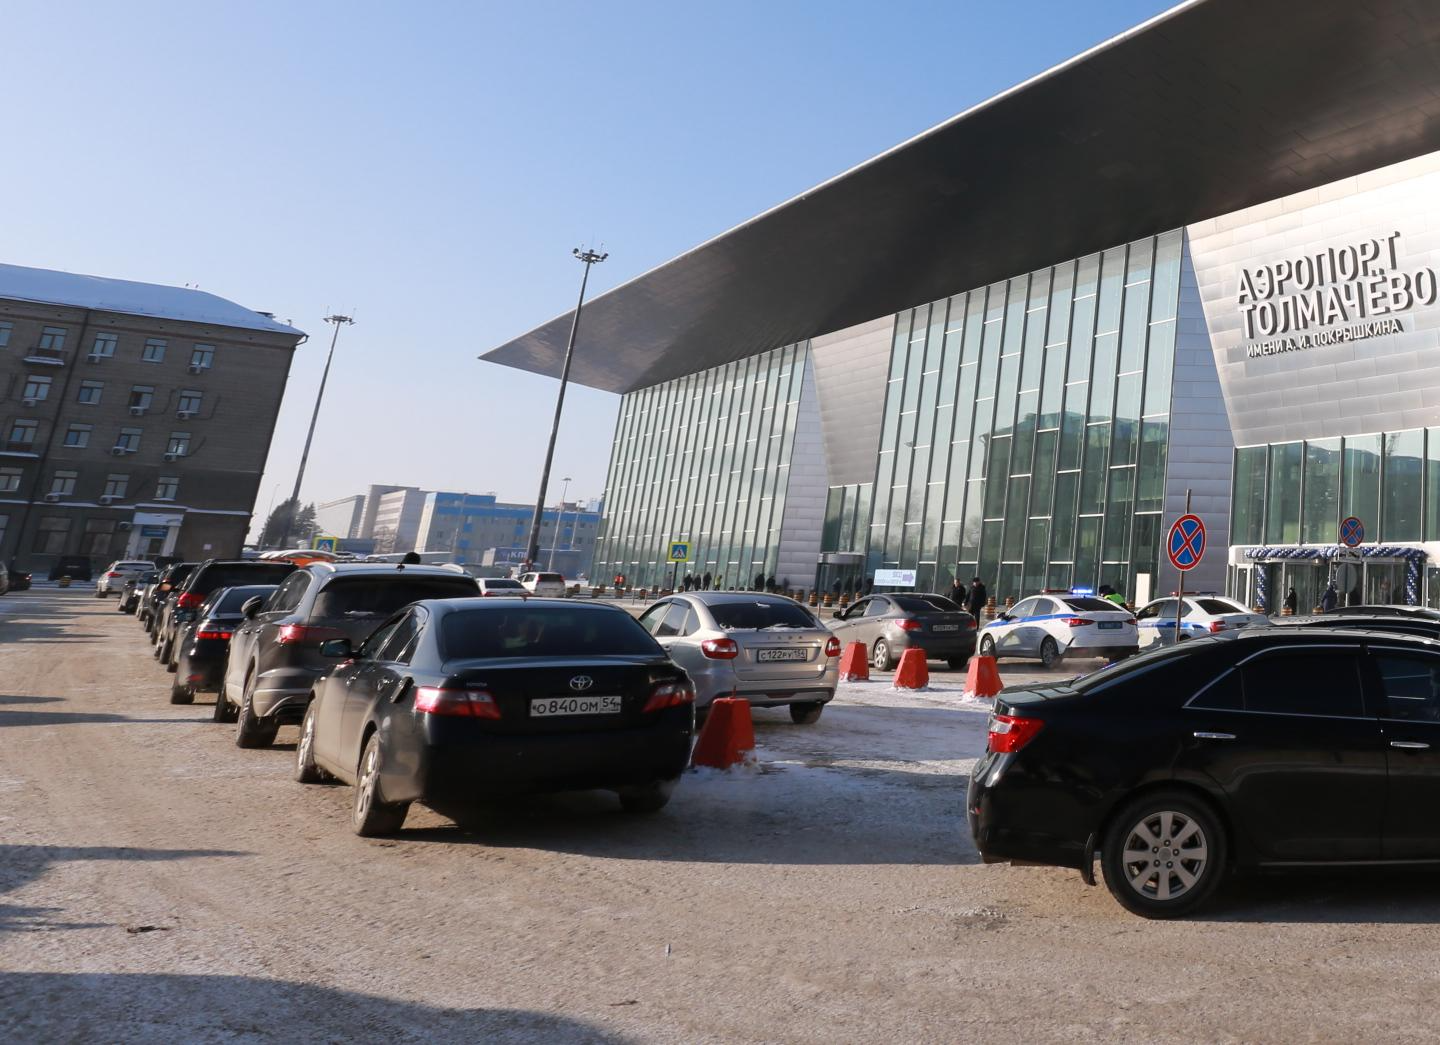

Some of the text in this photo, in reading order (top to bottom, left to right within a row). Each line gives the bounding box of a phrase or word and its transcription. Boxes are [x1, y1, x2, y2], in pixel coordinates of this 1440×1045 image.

[1237, 231, 1400, 303] АЭРОПОРТ
[1238, 268, 1438, 339] ТОЛМАЧЁВО
[1246, 340, 1284, 358] ИМЕНИ
[1312, 319, 1404, 347] ПОКРЫШКИНА
